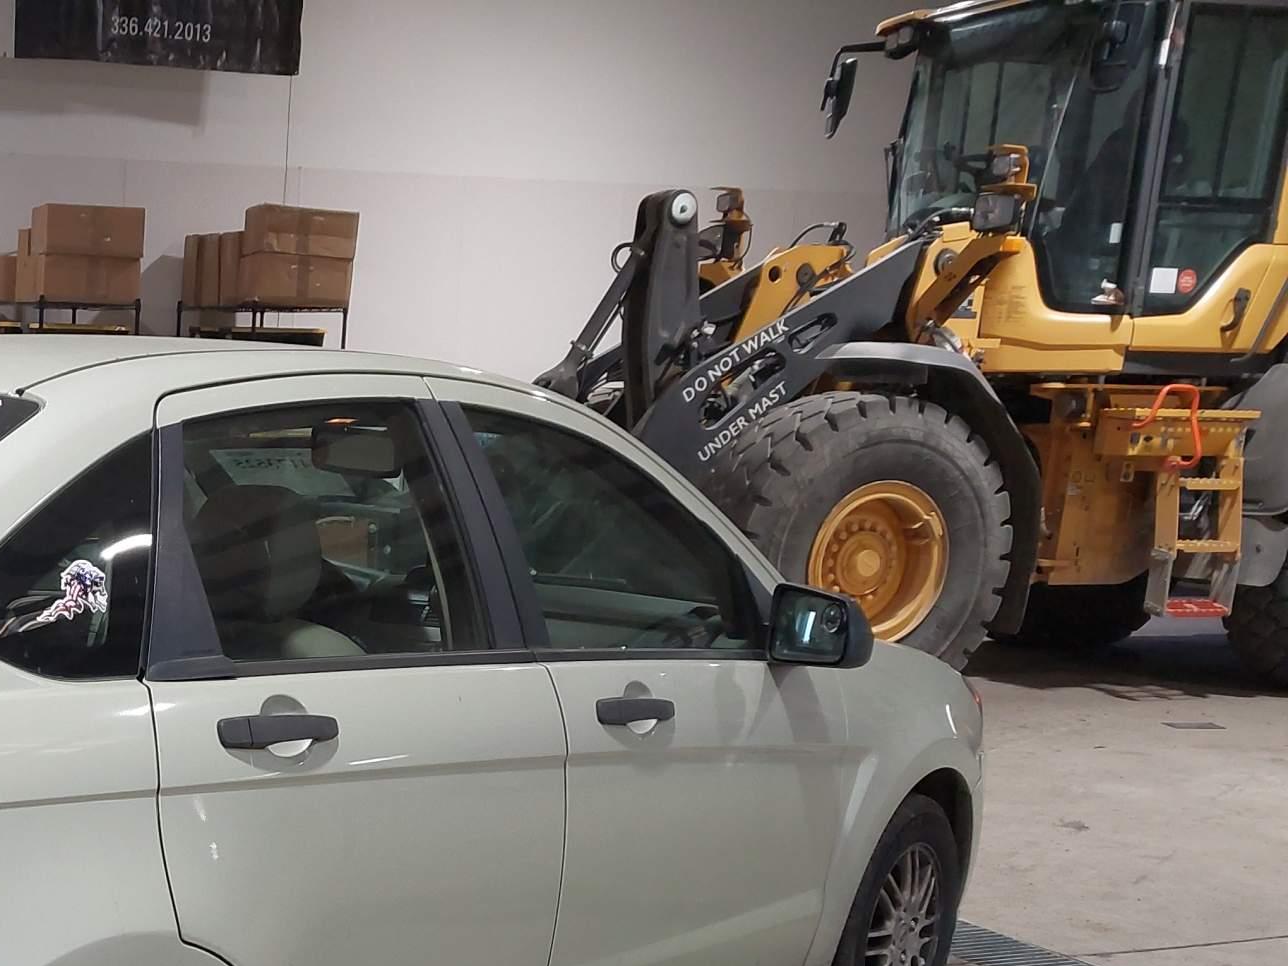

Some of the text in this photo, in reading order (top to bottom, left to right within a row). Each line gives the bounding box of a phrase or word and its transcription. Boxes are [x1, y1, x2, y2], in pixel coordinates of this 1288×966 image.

[111, 16, 211, 42] 336.421.2013
[682, 319, 790, 402] DO NOT WALK
[697, 381, 787, 462] UNDER MAST
